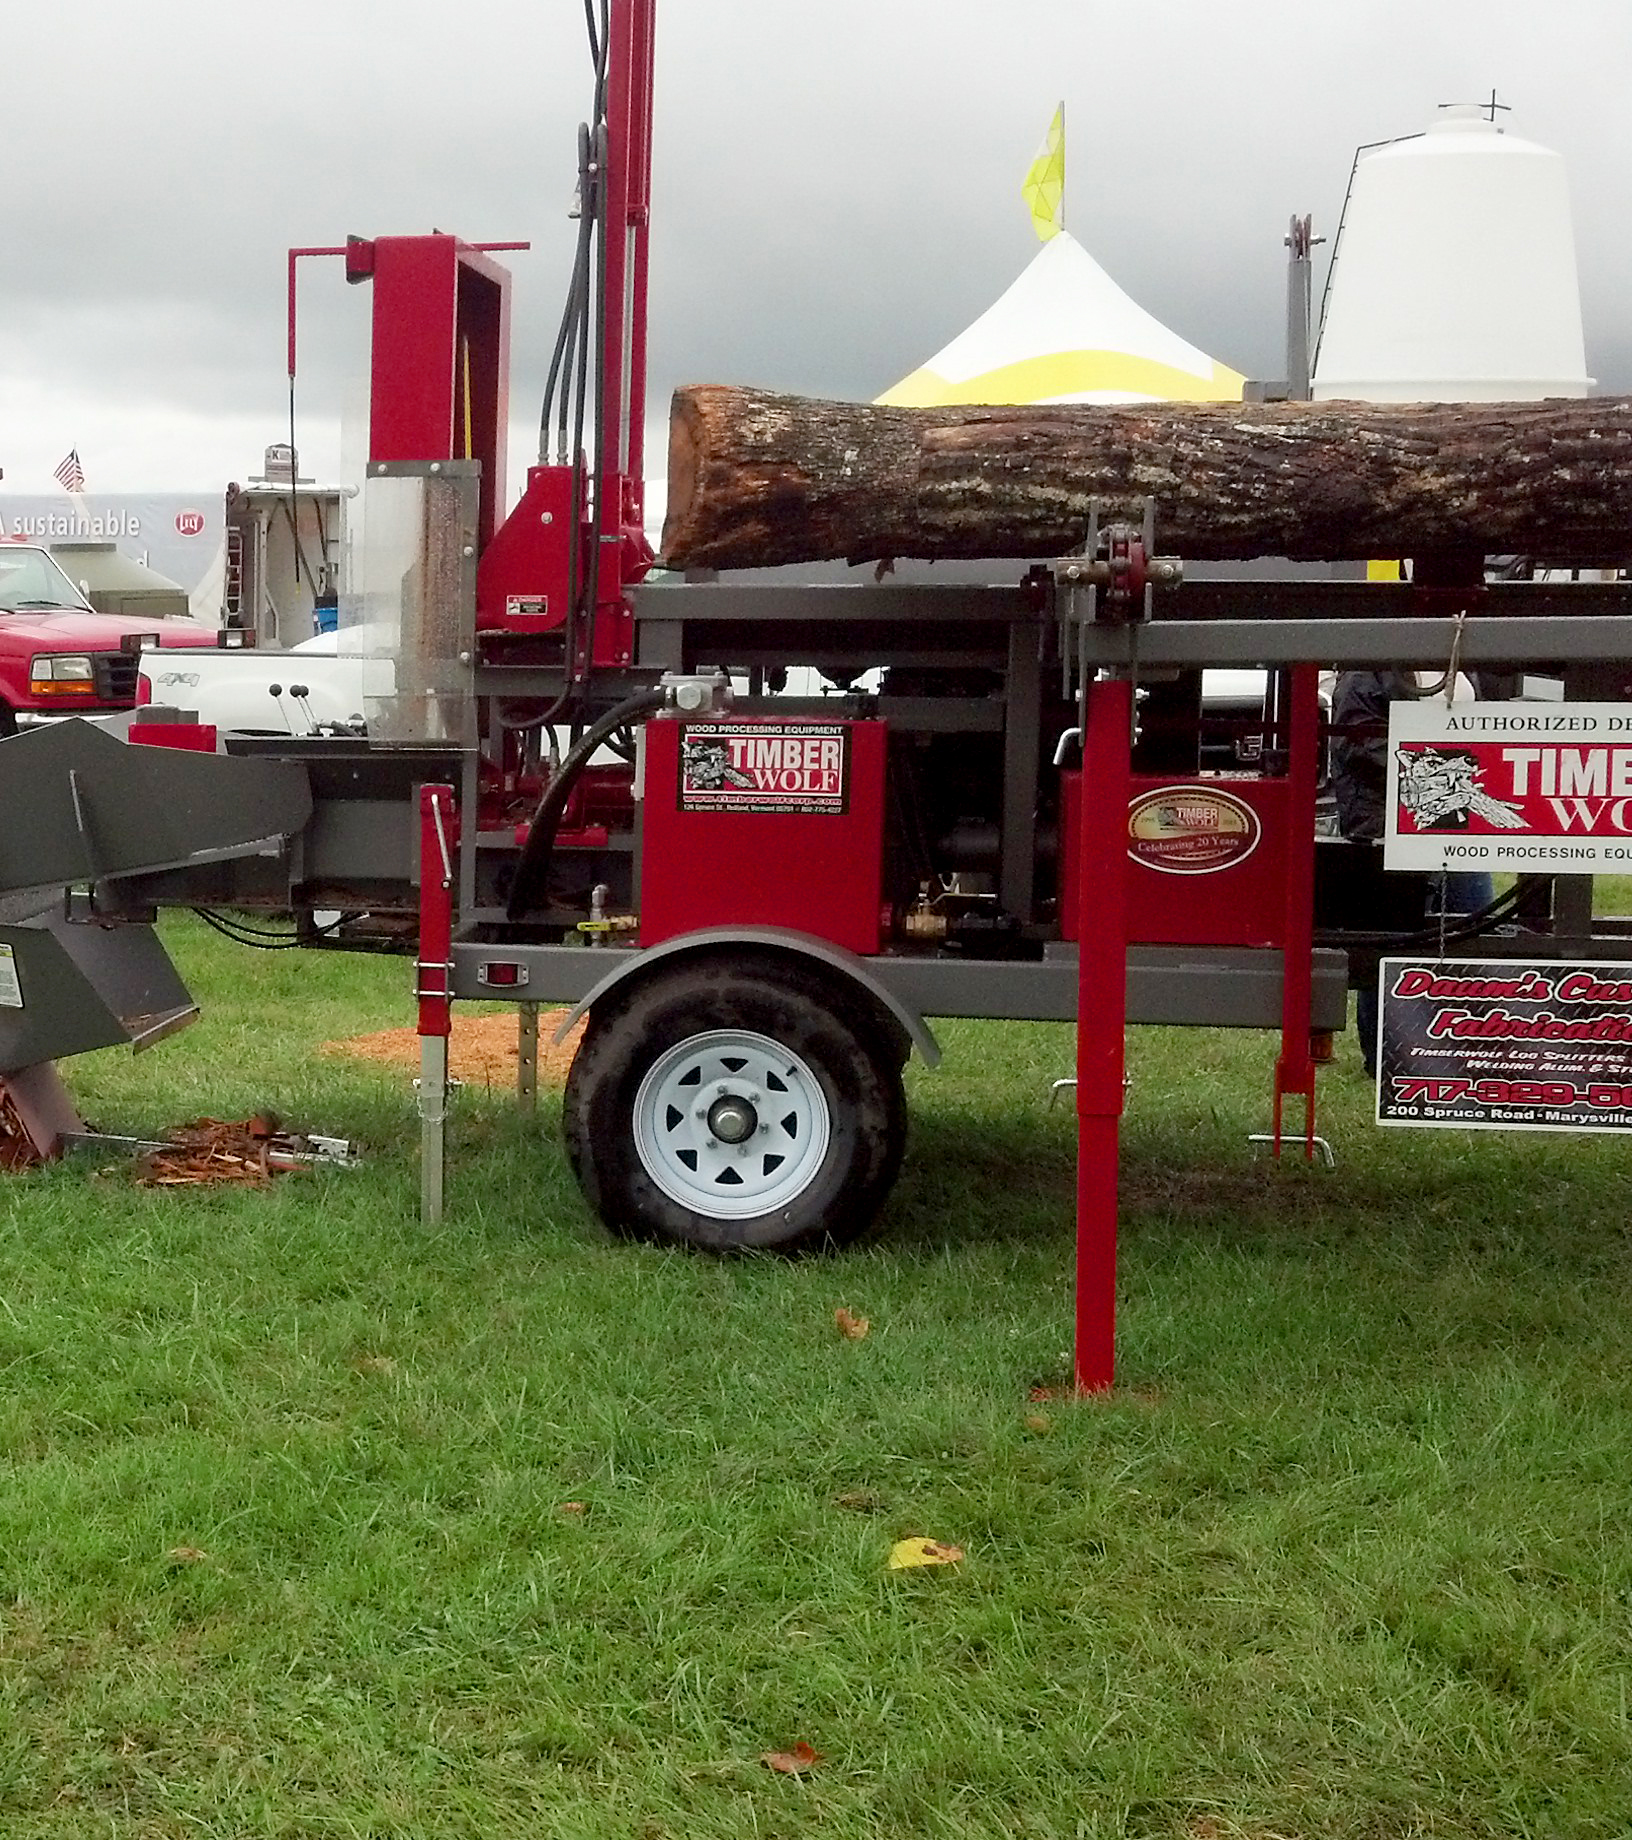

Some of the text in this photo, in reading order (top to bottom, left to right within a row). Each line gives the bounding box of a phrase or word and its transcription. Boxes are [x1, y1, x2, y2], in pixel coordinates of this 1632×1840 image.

[13, 509, 140, 538] sustainable
[686, 724, 843, 735] WOOD PROCESSING EQUIPMENT
[1446, 717, 1597, 731] AUTHORIZED
[729, 739, 839, 770] TIMBER
[754, 769, 838, 791] WOLF
[1176, 807, 1218, 818] TIMBER
[1186, 818, 1215, 826] WOLF
[1138, 836, 1239, 852] Celebrating 20 Years
[1444, 846, 1489, 858] WOOD
[1497, 847, 1596, 859] PROCESSING
[1589, 1064, 1603, 1073] &
[1387, 1106, 1418, 1116] 200
[1424, 1107, 1485, 1119] Spruce
[1491, 1108, 1534, 1119] Road
